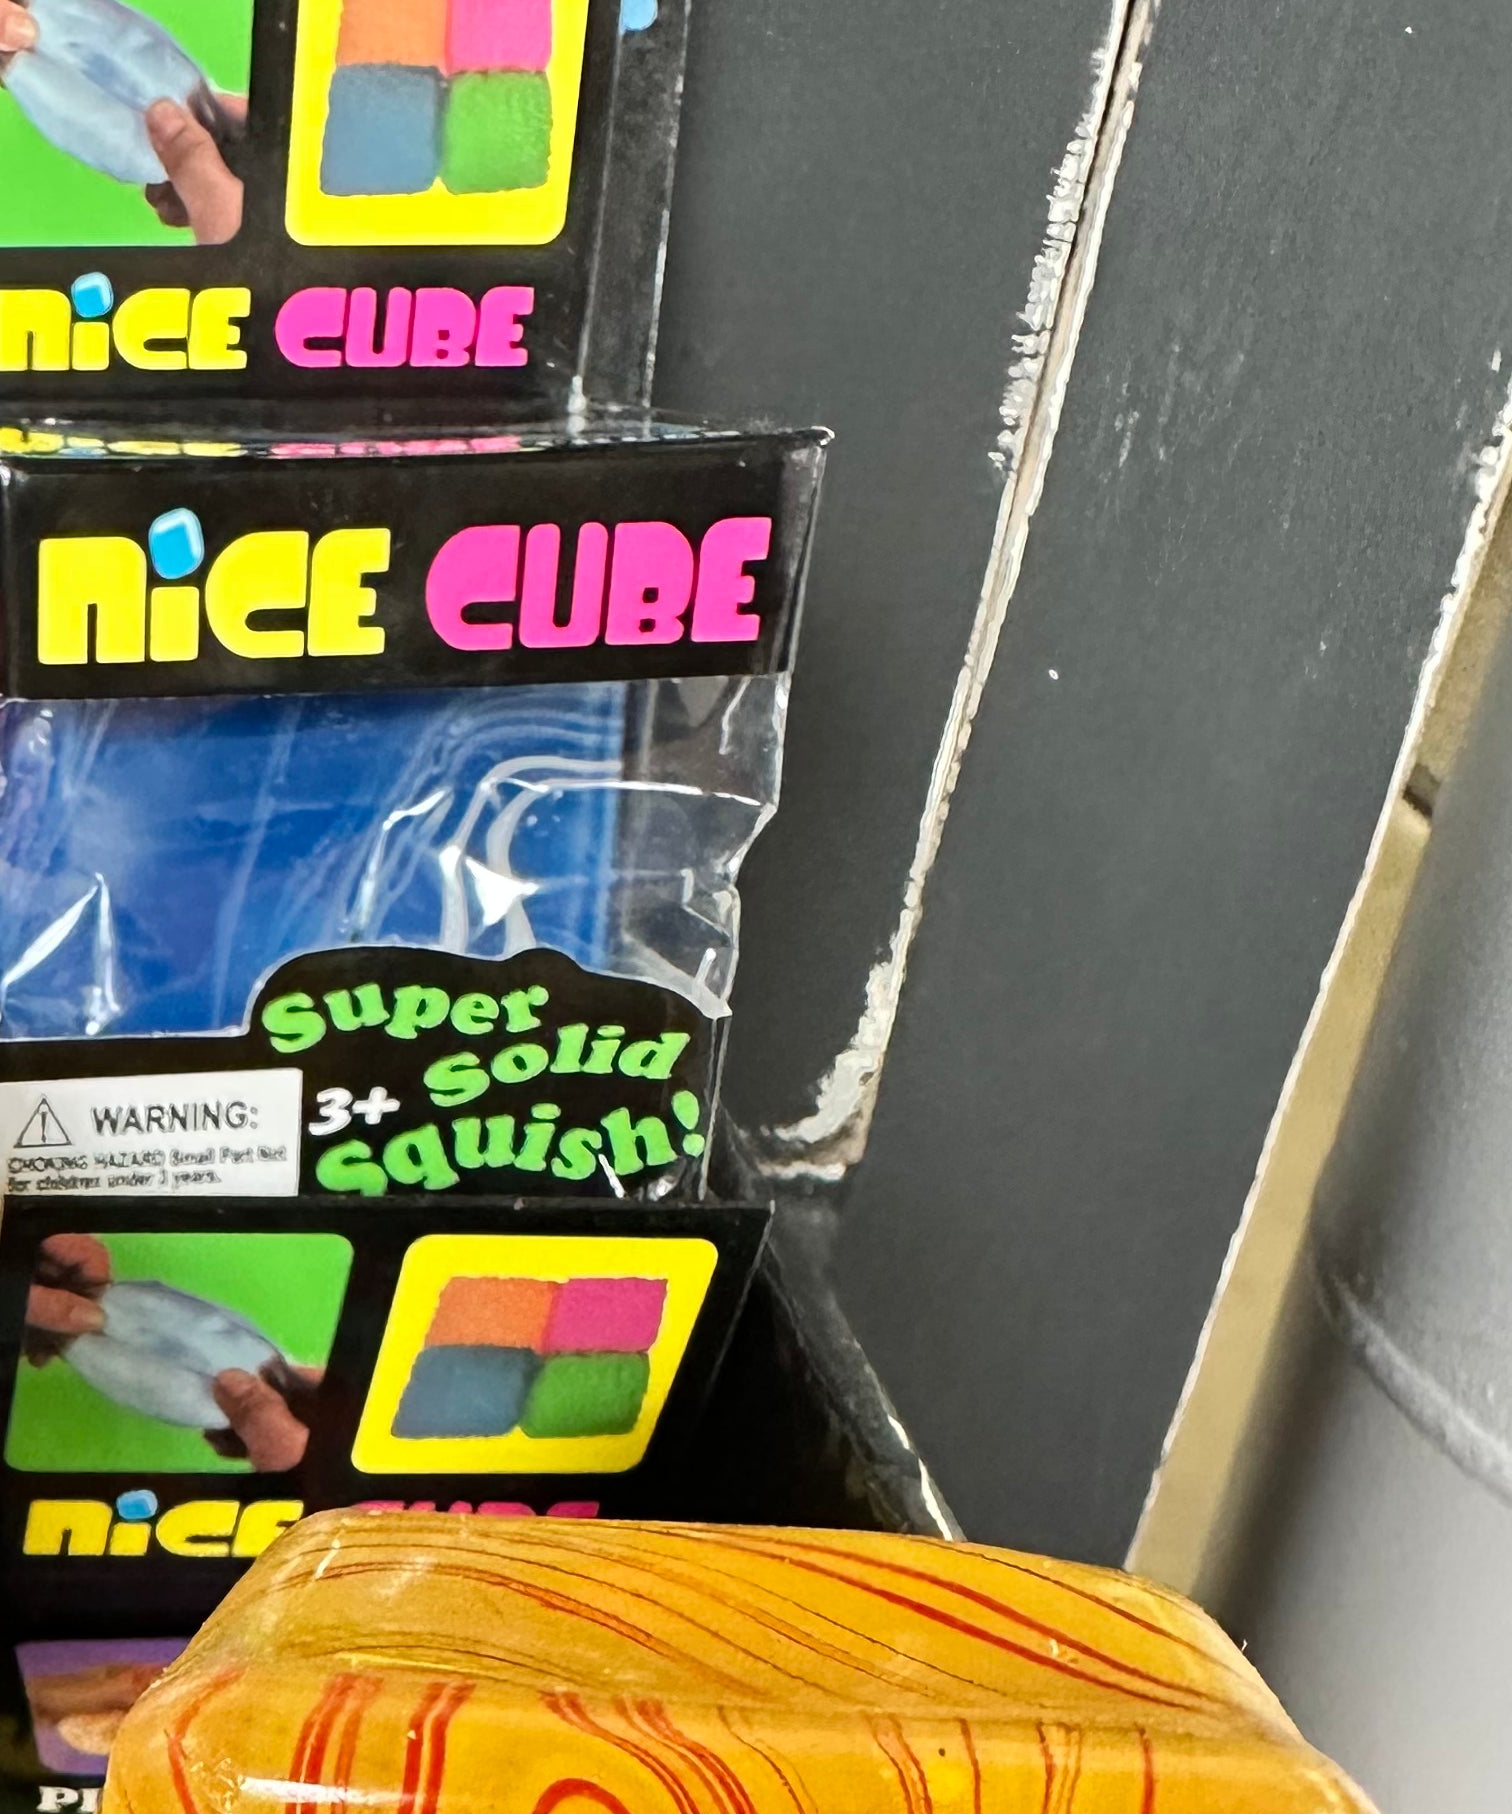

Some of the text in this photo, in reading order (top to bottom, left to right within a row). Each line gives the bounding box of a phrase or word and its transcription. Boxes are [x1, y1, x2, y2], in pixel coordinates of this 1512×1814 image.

[274, 285, 536, 369] CUBE
[425, 517, 773, 652] CUBE
[261, 983, 550, 1054] Super
[424, 1023, 692, 1108] Solid
[90, 1099, 259, 1137] WARNING:
[308, 1086, 402, 1137] 3+
[315, 1089, 707, 1197] Squish!
